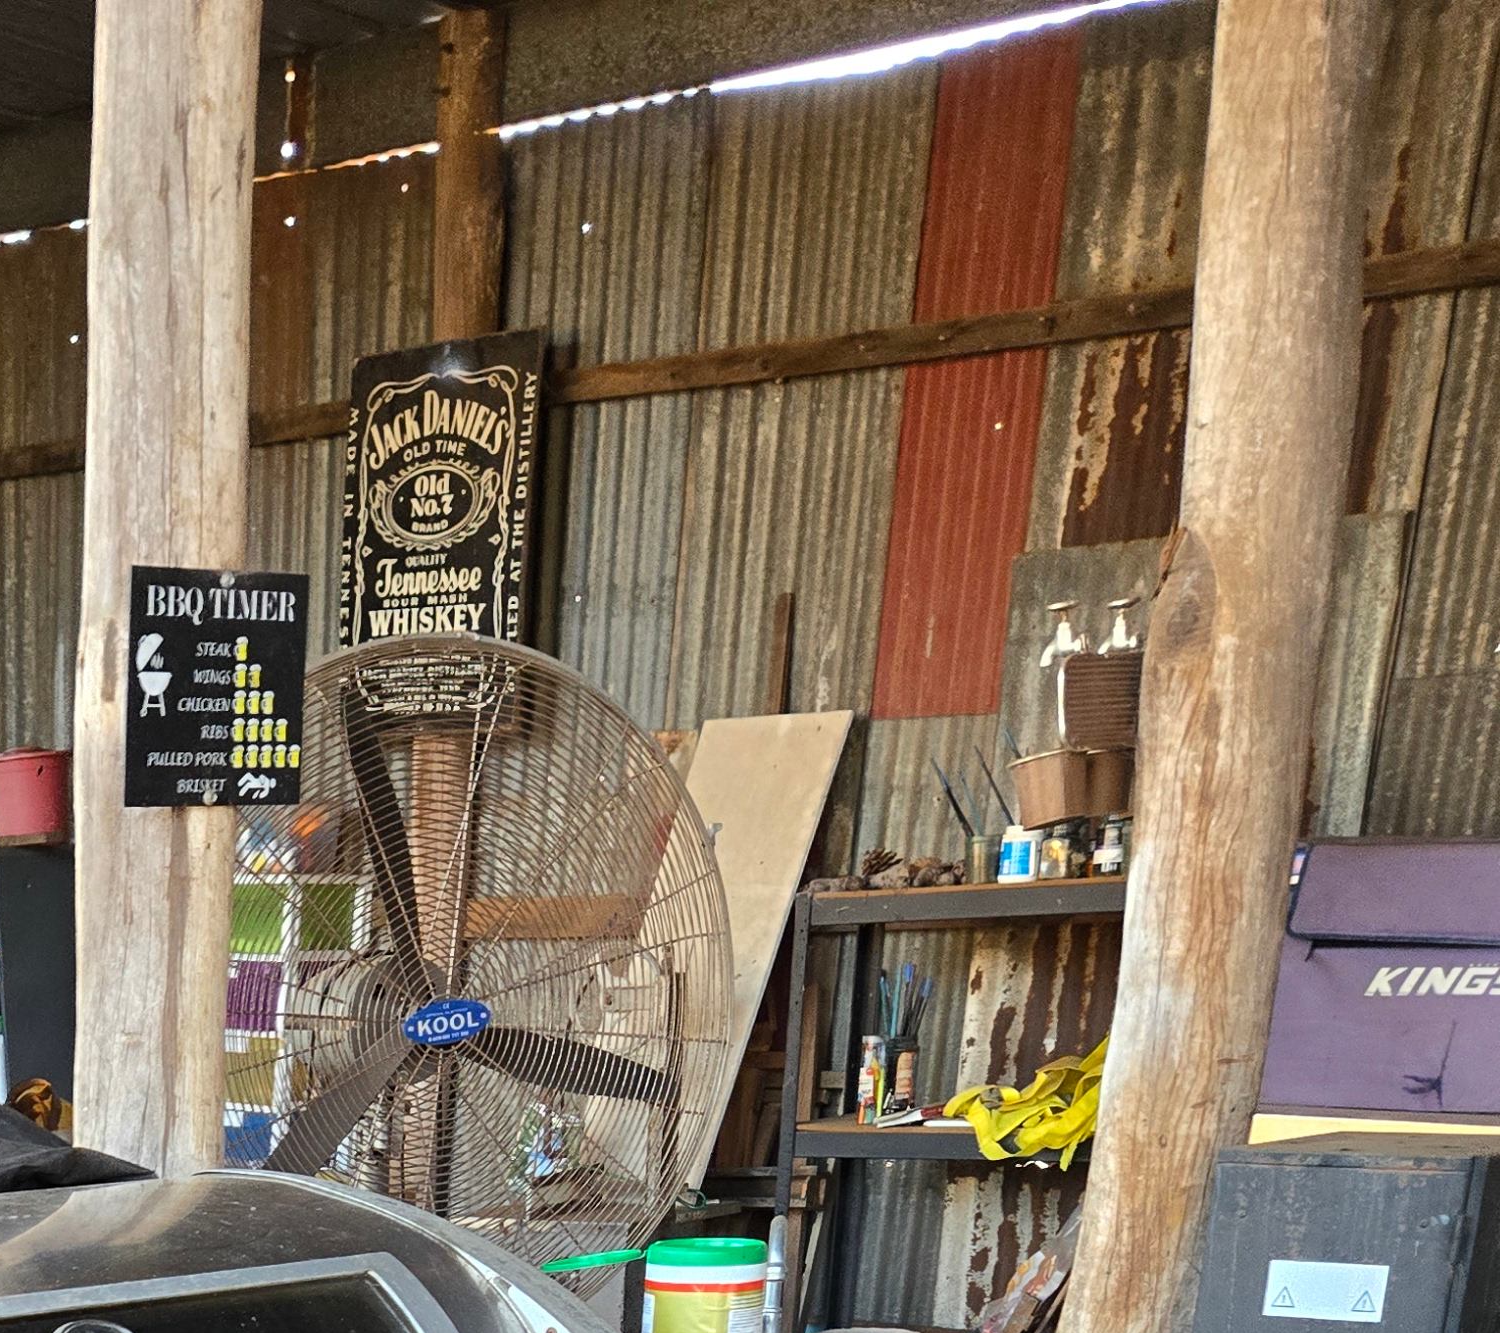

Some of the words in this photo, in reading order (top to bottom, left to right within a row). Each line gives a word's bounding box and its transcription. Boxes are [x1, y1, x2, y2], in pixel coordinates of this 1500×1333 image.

[346, 407, 360, 476] MADE
[369, 405, 421, 470] JACK
[515, 372, 539, 500] DISTILLERY
[403, 442, 431, 462] OLD
[435, 440, 467, 456] TIME
[414, 472, 451, 497] Old
[344, 493, 354, 518] IN
[411, 519, 449, 533] BRAND
[511, 508, 527, 549] THE
[405, 553, 448, 568] QUALITY
[509, 559, 522, 582] AT
[375, 558, 482, 598] Tennessee
[146, 584, 204, 625] BBQ
[208, 587, 296, 622] TIMER
[383, 597, 419, 608] SOUR
[427, 593, 468, 605] MASH
[368, 603, 487, 637] WHISKEY
[195, 642, 232, 657] STEAK
[193, 669, 232, 686] WINGS
[177, 697, 231, 712] CHICKEN
[200, 725, 229, 739] RIBS
[147, 751, 193, 767] PULLED
[194, 752, 228, 767] PORK
[176, 778, 227, 794] BRISKET
[417, 1011, 479, 1037] KOOL
